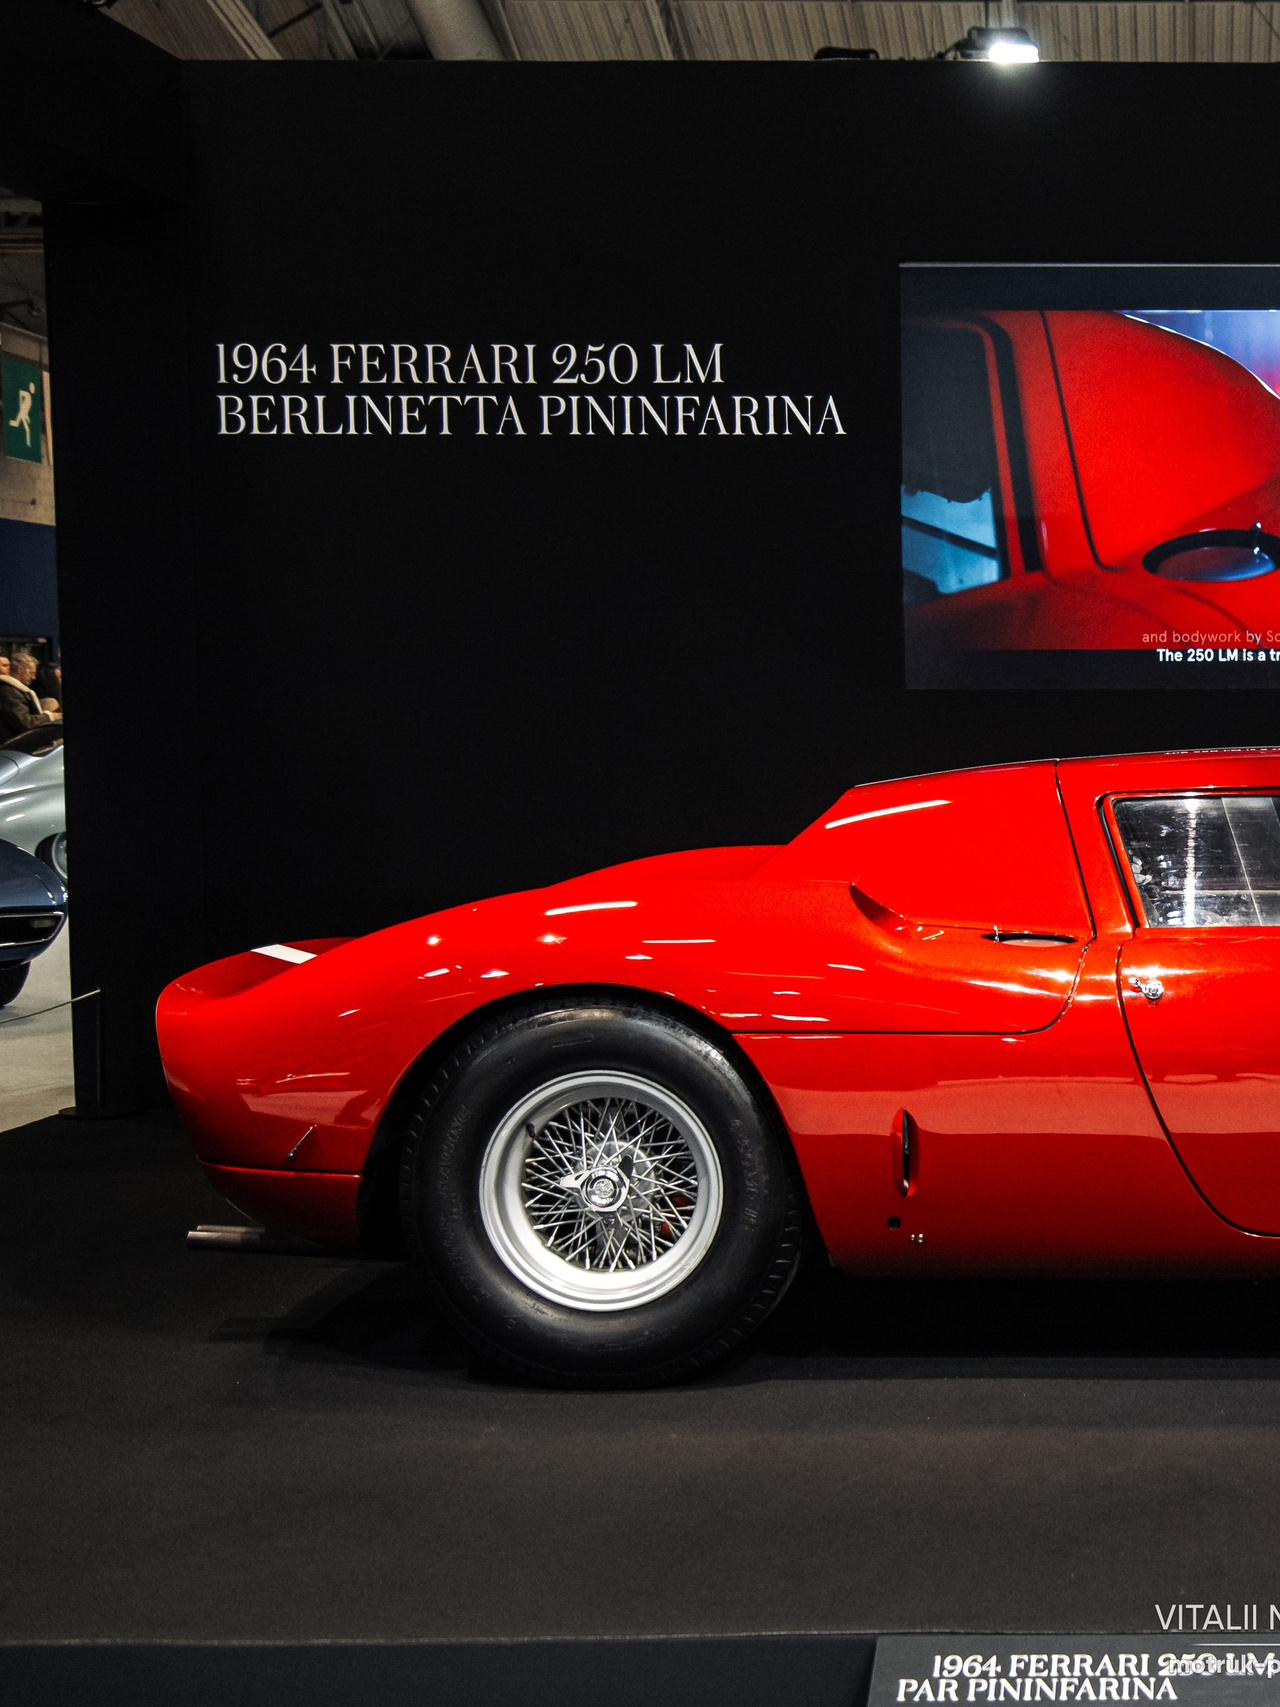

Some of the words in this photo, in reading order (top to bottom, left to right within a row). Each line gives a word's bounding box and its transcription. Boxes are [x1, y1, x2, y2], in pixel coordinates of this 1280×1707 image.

[217, 343, 316, 384] 1964
[330, 343, 538, 384] FERRARI
[552, 343, 639, 385] 250
[653, 343, 725, 384] LM
[217, 395, 527, 436] BERLINETTA
[539, 395, 848, 436] PININFARINA
[1142, 631, 1168, 643] and
[1172, 631, 1241, 645] bodywork
[1246, 631, 1262, 645] by
[1157, 648, 1183, 661] The
[1187, 648, 1214, 661] 250
[1218, 648, 1239, 661] LM
[1242, 648, 1254, 661] is
[1257, 651, 1266, 661] a
[933, 1654, 1002, 1677] 1964
[1008, 1653, 1150, 1677] FERRARI
[896, 1678, 960, 1702] PAR
[966, 1677, 1179, 1701] PININFARINA
